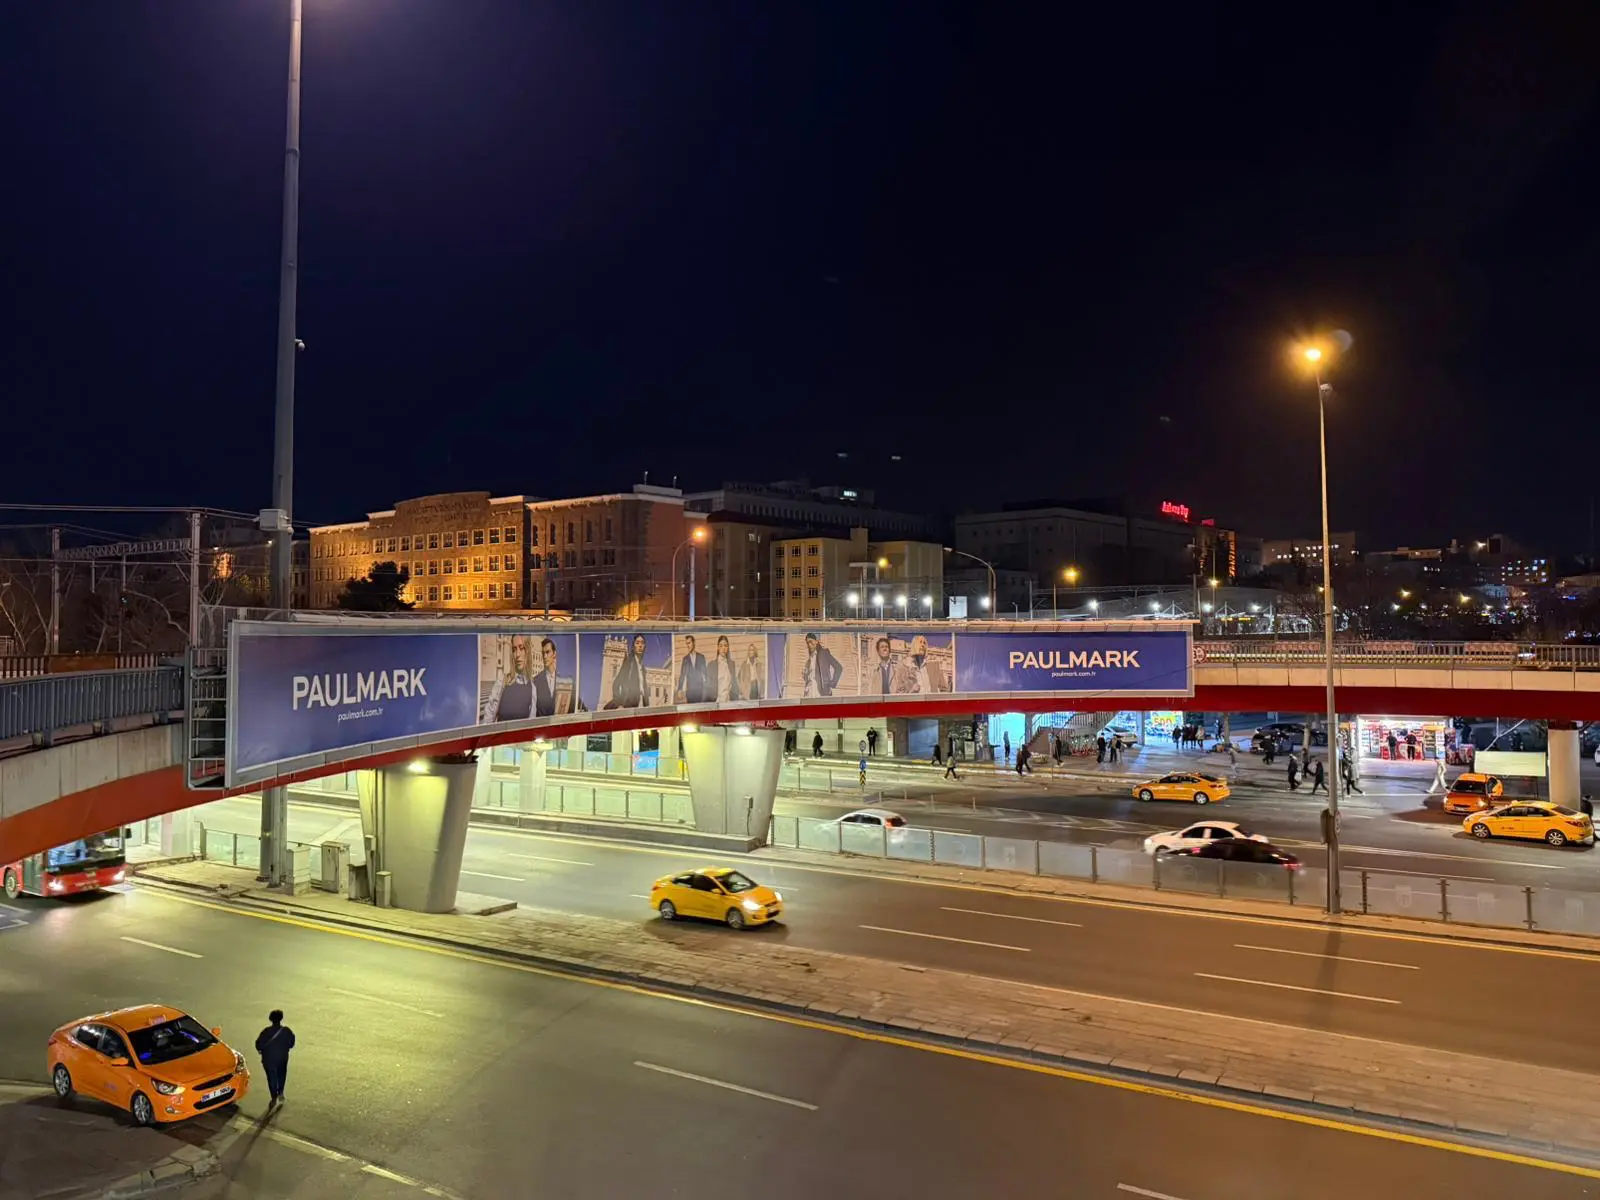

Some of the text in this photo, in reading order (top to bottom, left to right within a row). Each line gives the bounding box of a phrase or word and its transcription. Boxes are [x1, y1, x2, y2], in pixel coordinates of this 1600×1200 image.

[1009, 650, 1140, 669] PAULMARK
[1051, 670, 1097, 678] paulmark.com.tr
[293, 667, 427, 710] PAULMARK
[337, 707, 384, 722] paulmark.com.tr
